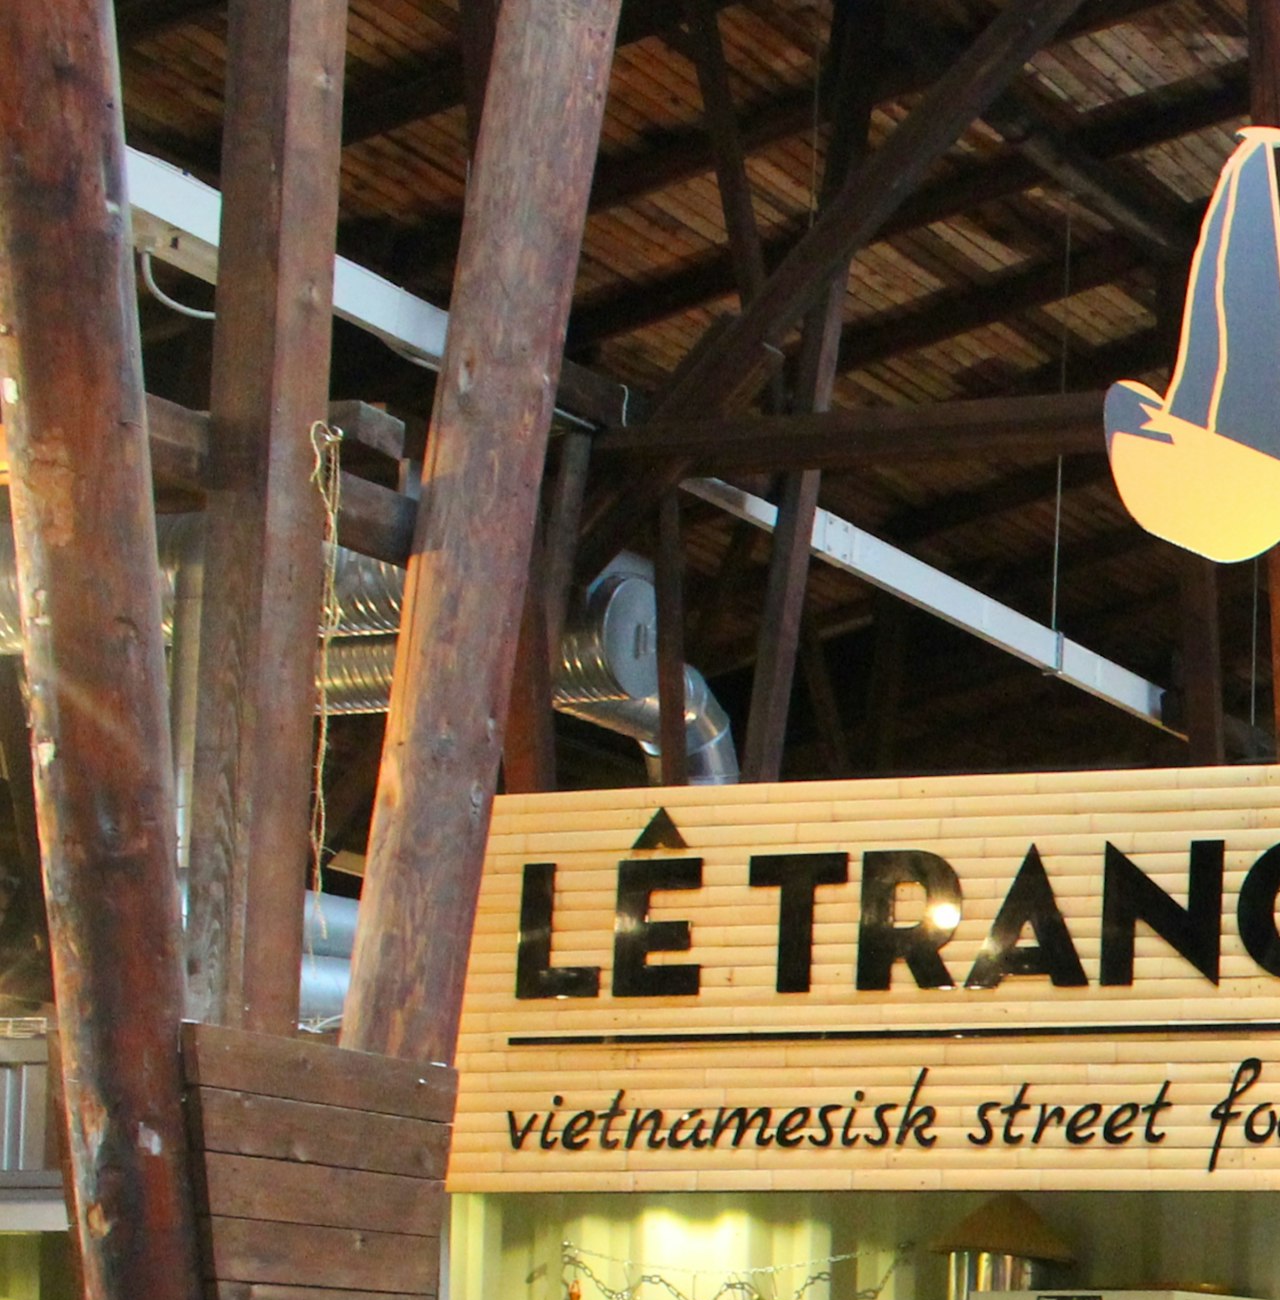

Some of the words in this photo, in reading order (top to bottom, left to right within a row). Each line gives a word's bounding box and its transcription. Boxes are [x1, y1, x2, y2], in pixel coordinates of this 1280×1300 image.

[514, 807, 705, 998] LÊ
[506, 1066, 938, 1151] vietnamesisk
[967, 1079, 1173, 1148] street
